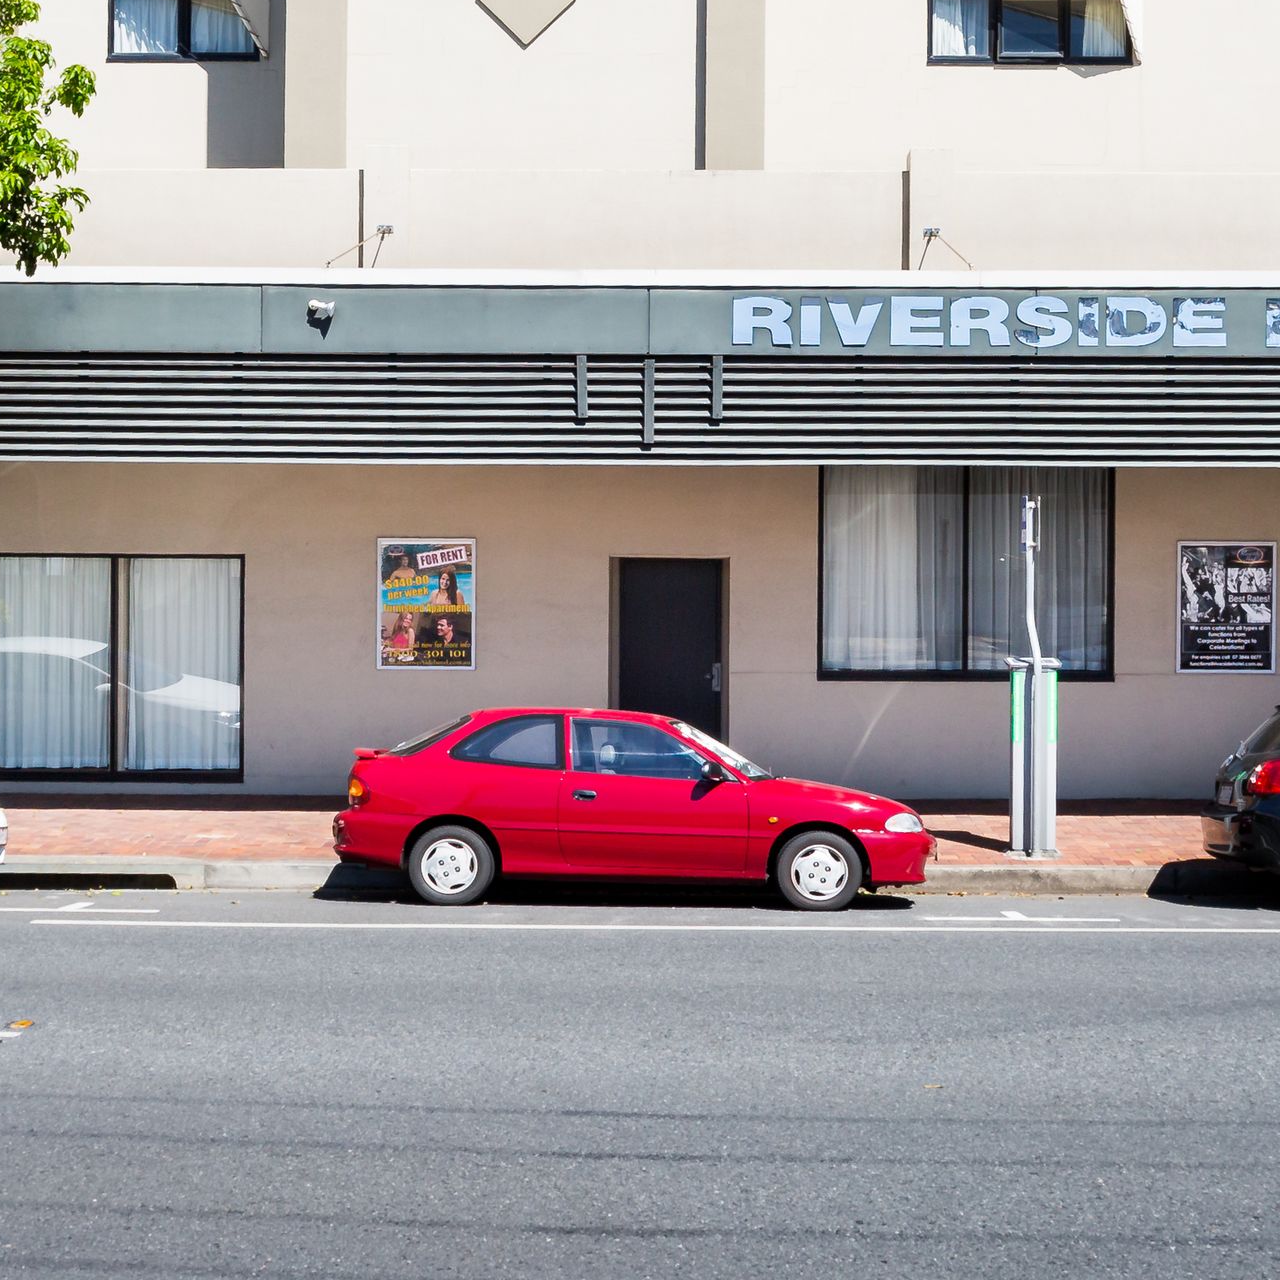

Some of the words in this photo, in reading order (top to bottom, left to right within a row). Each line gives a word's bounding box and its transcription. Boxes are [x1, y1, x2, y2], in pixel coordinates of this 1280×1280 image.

[731, 295, 1229, 348] RIVERSIDE
[419, 553, 439, 566] FOR
[439, 549, 464, 563] RENT
[404, 587, 429, 598] week
[1228, 594, 1245, 603] Best
[1246, 594, 1271, 603] Rates!
[423, 650, 443, 658] 301
[448, 649, 466, 658] 101
